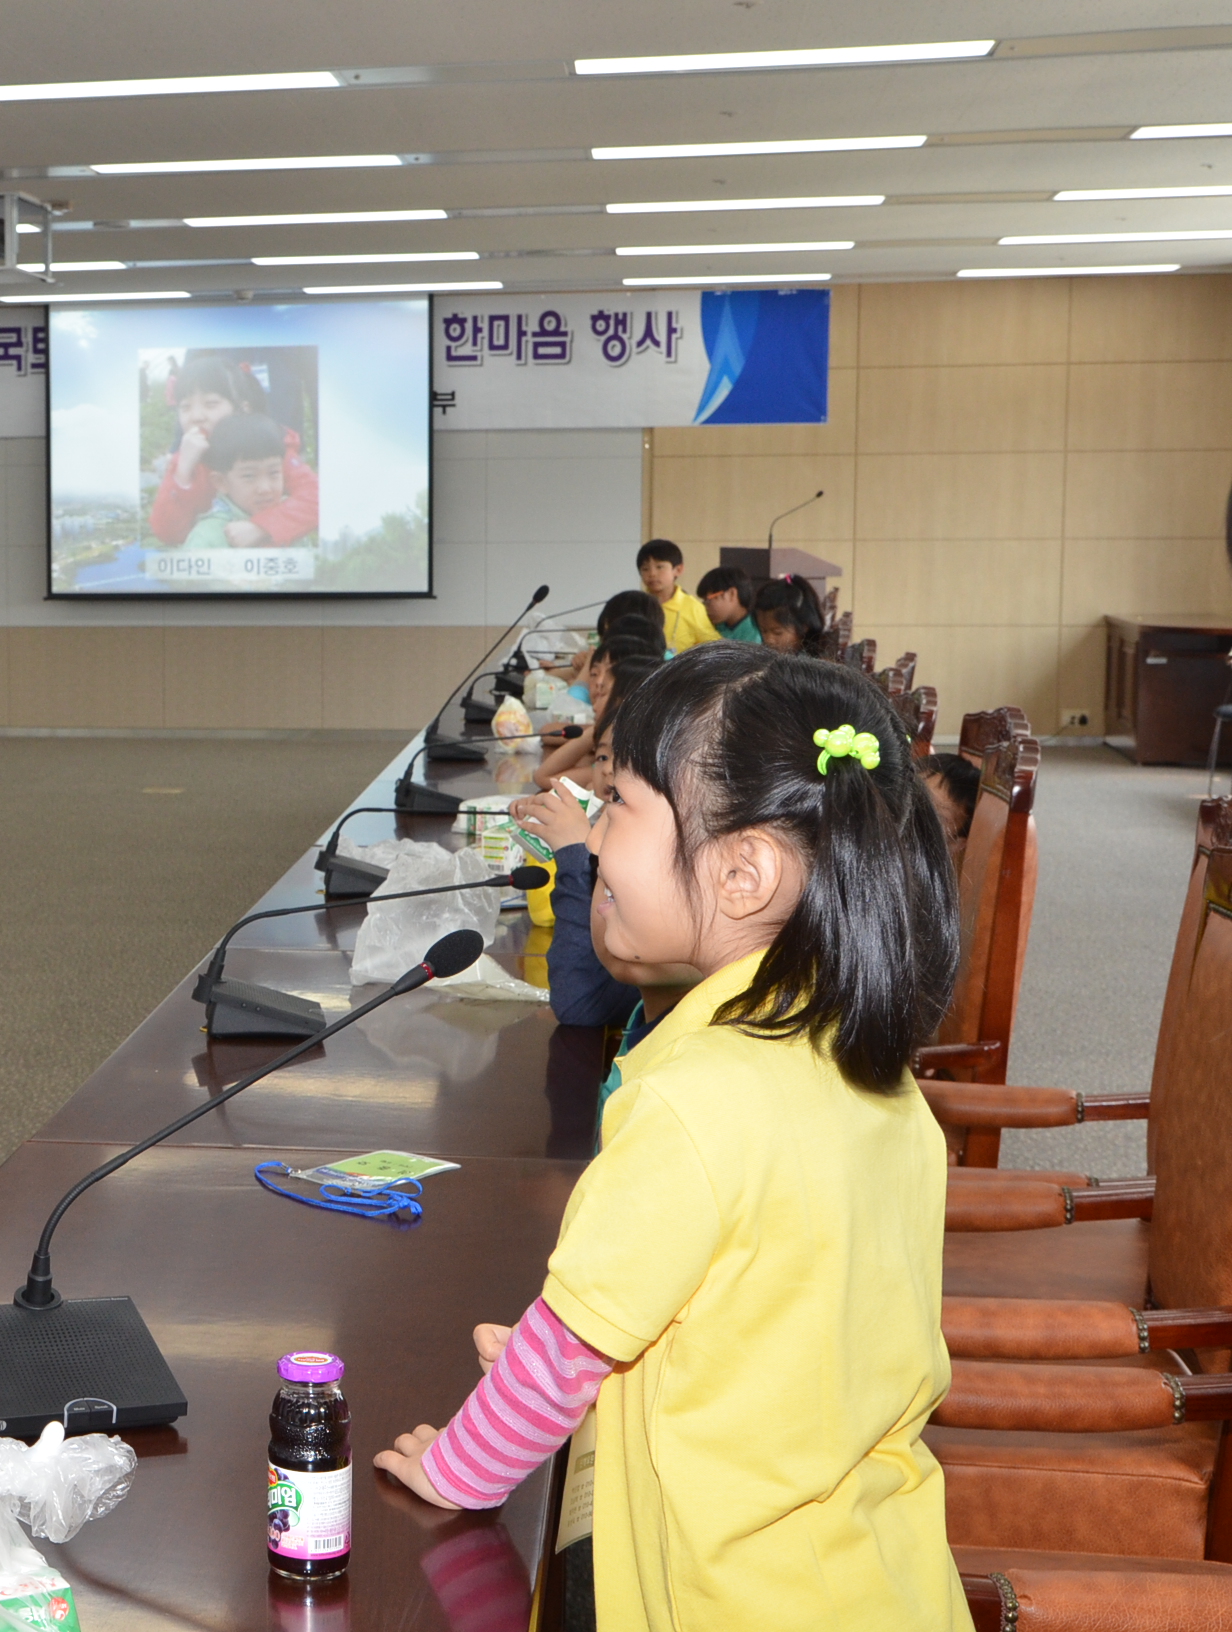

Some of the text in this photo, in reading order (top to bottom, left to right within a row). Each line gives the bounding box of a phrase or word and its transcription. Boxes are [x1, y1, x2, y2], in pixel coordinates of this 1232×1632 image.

[443, 310, 569, 363] 한마음
[590, 310, 679, 363] 행사
[158, 557, 212, 577] 이다인
